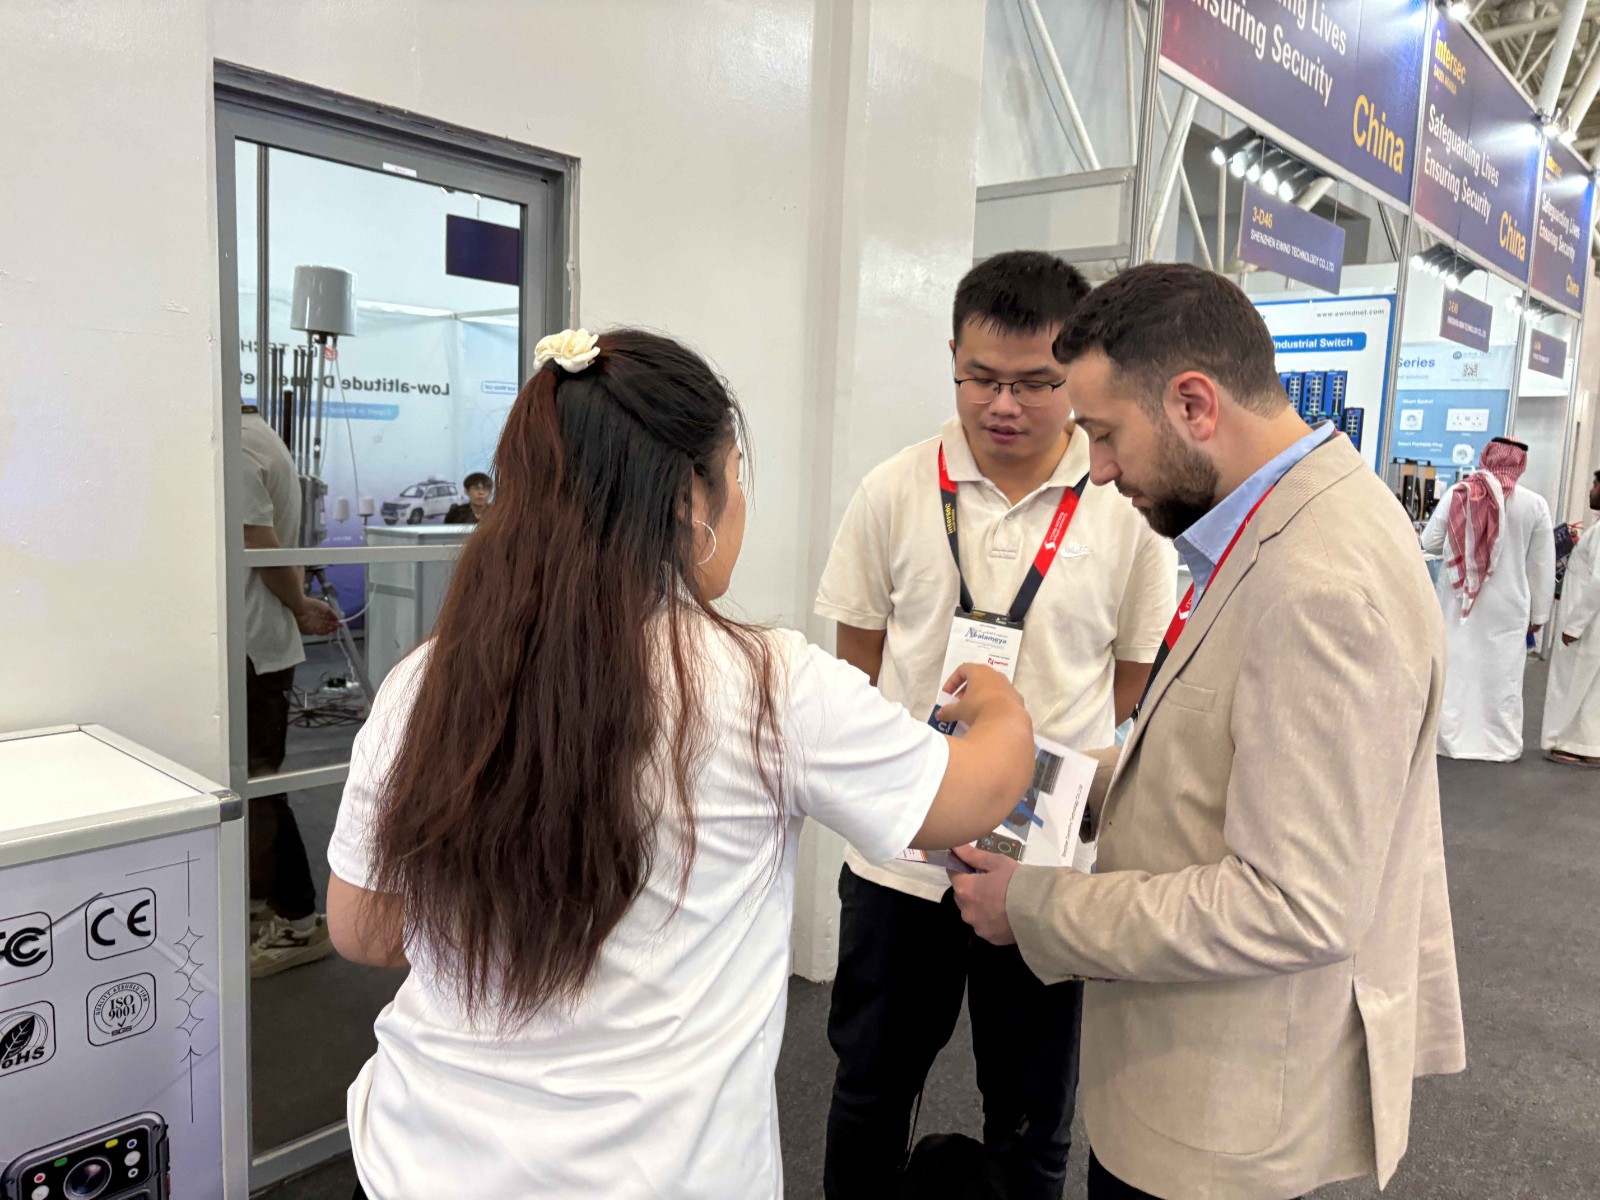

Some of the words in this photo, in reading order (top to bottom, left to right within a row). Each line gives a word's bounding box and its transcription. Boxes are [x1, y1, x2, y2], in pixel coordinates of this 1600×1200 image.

[1311, 0, 1347, 56] Lives
[1190, 0, 1267, 61] suring
[1271, 24, 1333, 107] Security
[1435, 29, 1466, 86] intersec
[1353, 94, 1404, 175] China
[1428, 103, 1480, 178] Safeguarding
[1481, 152, 1499, 188] Lives
[1424, 146, 1460, 203] Ensuring
[1461, 176, 1491, 225] Security
[1252, 206, 1273, 229] 3-D46
[1499, 210, 1526, 262] China
[1250, 228, 1276, 249] SHENZHEN
[1291, 246, 1319, 266] TECHNOLOGY
[1316, 308, 1384, 318] www.ewindnet.com
[1319, 337, 1353, 349] Switch
[91, 899, 152, 946] CE
[108, 1004, 136, 1020] 9001
[110, 994, 134, 1010] ISO
